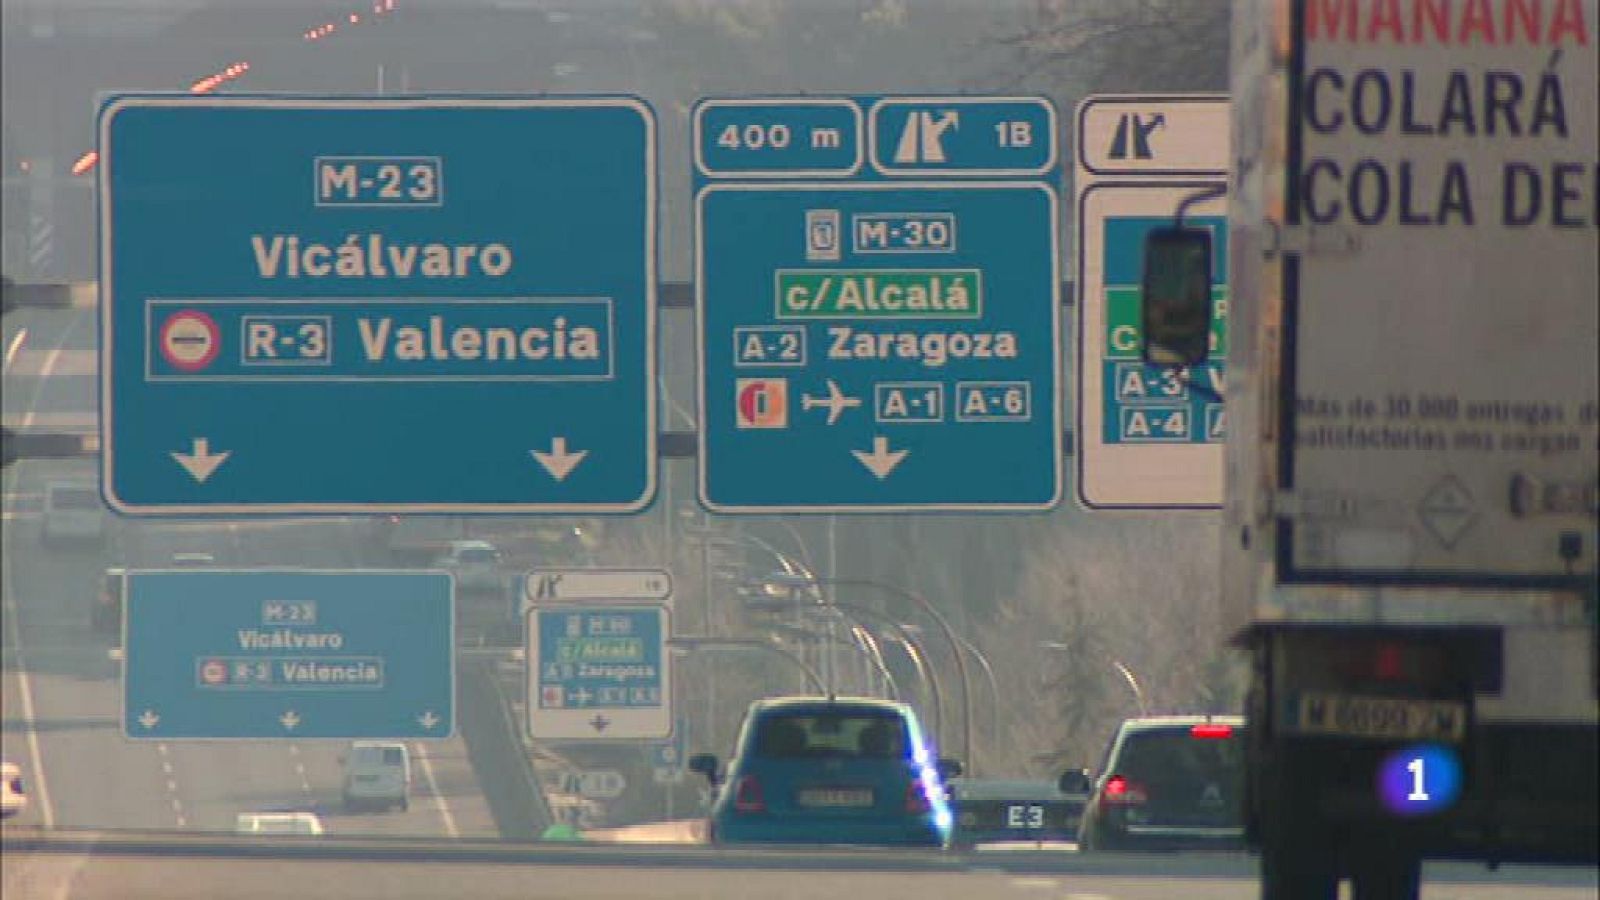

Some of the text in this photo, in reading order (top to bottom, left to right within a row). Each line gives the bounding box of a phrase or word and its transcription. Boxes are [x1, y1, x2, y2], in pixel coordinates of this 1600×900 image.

[1305, 49, 1568, 137] COLARÁ
[718, 124, 840, 149] 400 m
[995, 121, 1032, 147] 1B
[321, 164, 435, 200] M-23
[1305, 159, 1599, 226] COLA DE
[860, 221, 947, 246] M-30
[251, 234, 512, 278] Vicálvaro
[786, 277, 969, 311] c/Alcalá
[248, 316, 600, 361] R-3 Valencia
[743, 326, 1018, 366] A-2 Zaragoza
[1121, 371, 1183, 397] A-3
[884, 388, 1024, 417] A-1 A-6
[1126, 408, 1186, 437] A-4
[238, 630, 343, 650] Vicálvaro
[283, 662, 378, 682] Valencia
[1008, 805, 1043, 828] E3
